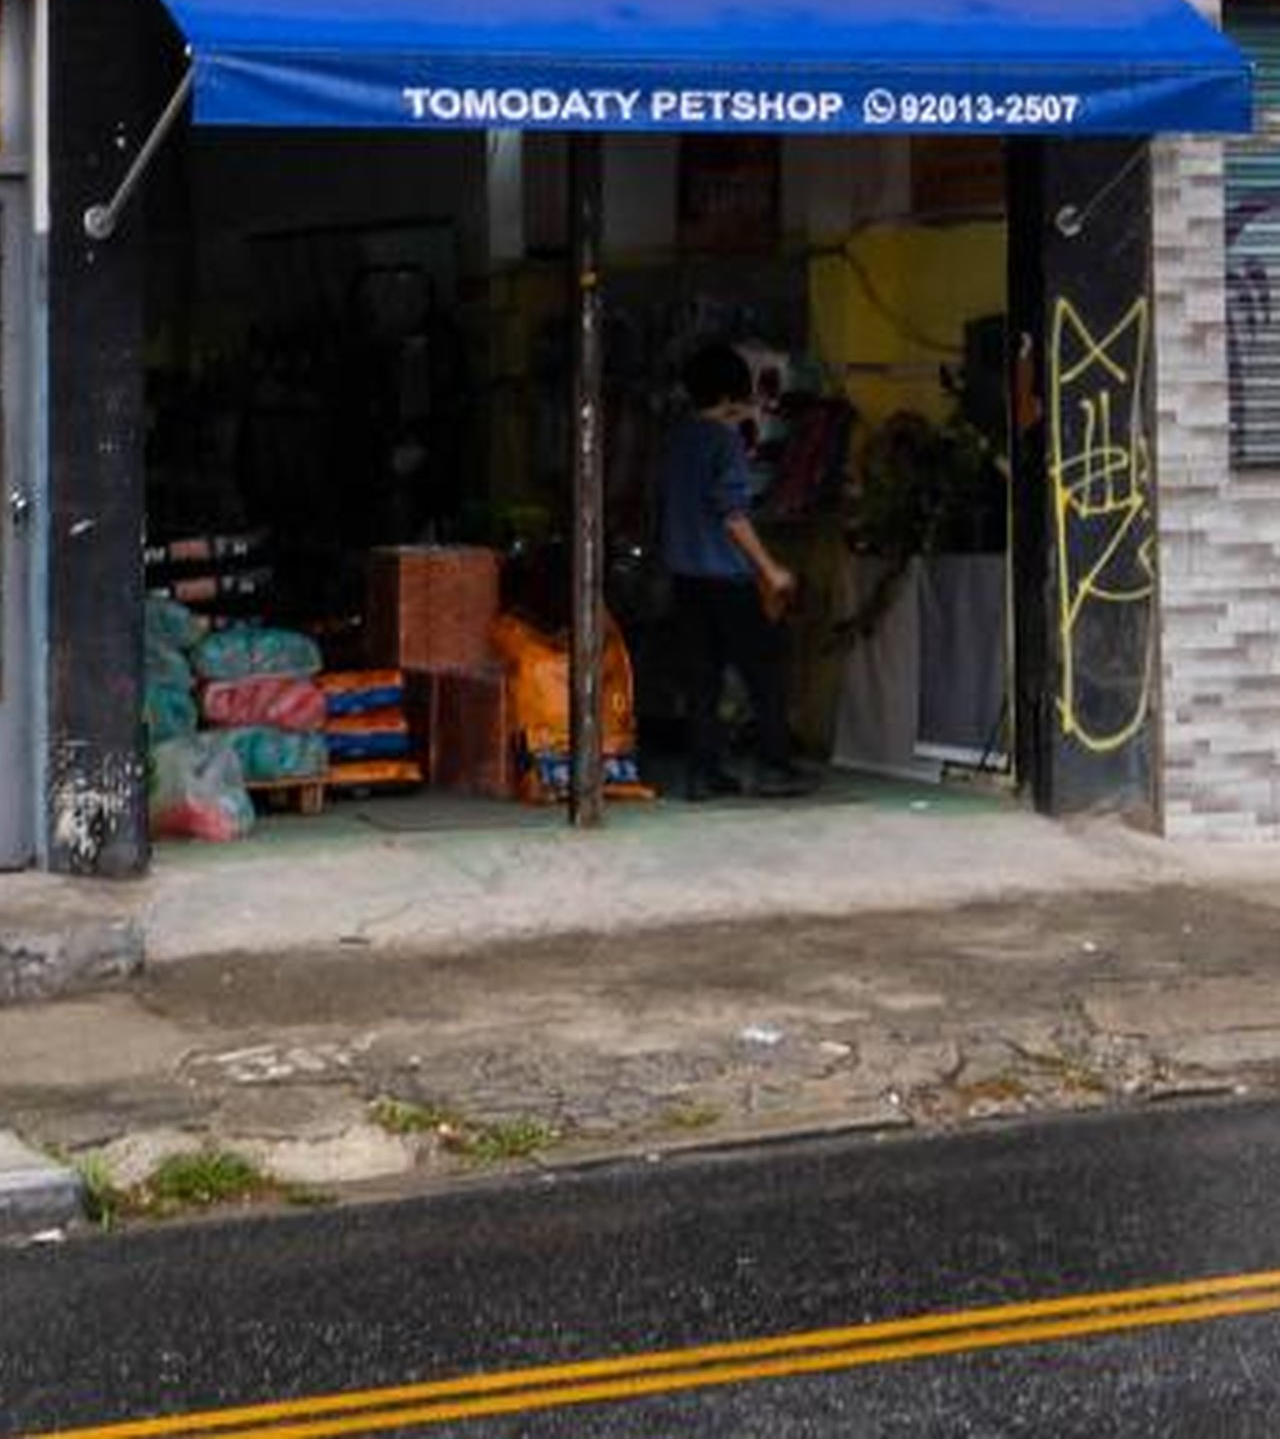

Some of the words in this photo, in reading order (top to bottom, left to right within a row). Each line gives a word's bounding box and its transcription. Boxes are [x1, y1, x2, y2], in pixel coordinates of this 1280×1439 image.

[403, 87, 641, 121] TOMODATY
[651, 89, 843, 122] PETSHOP
[900, 93, 1081, 124] 92013-2507
